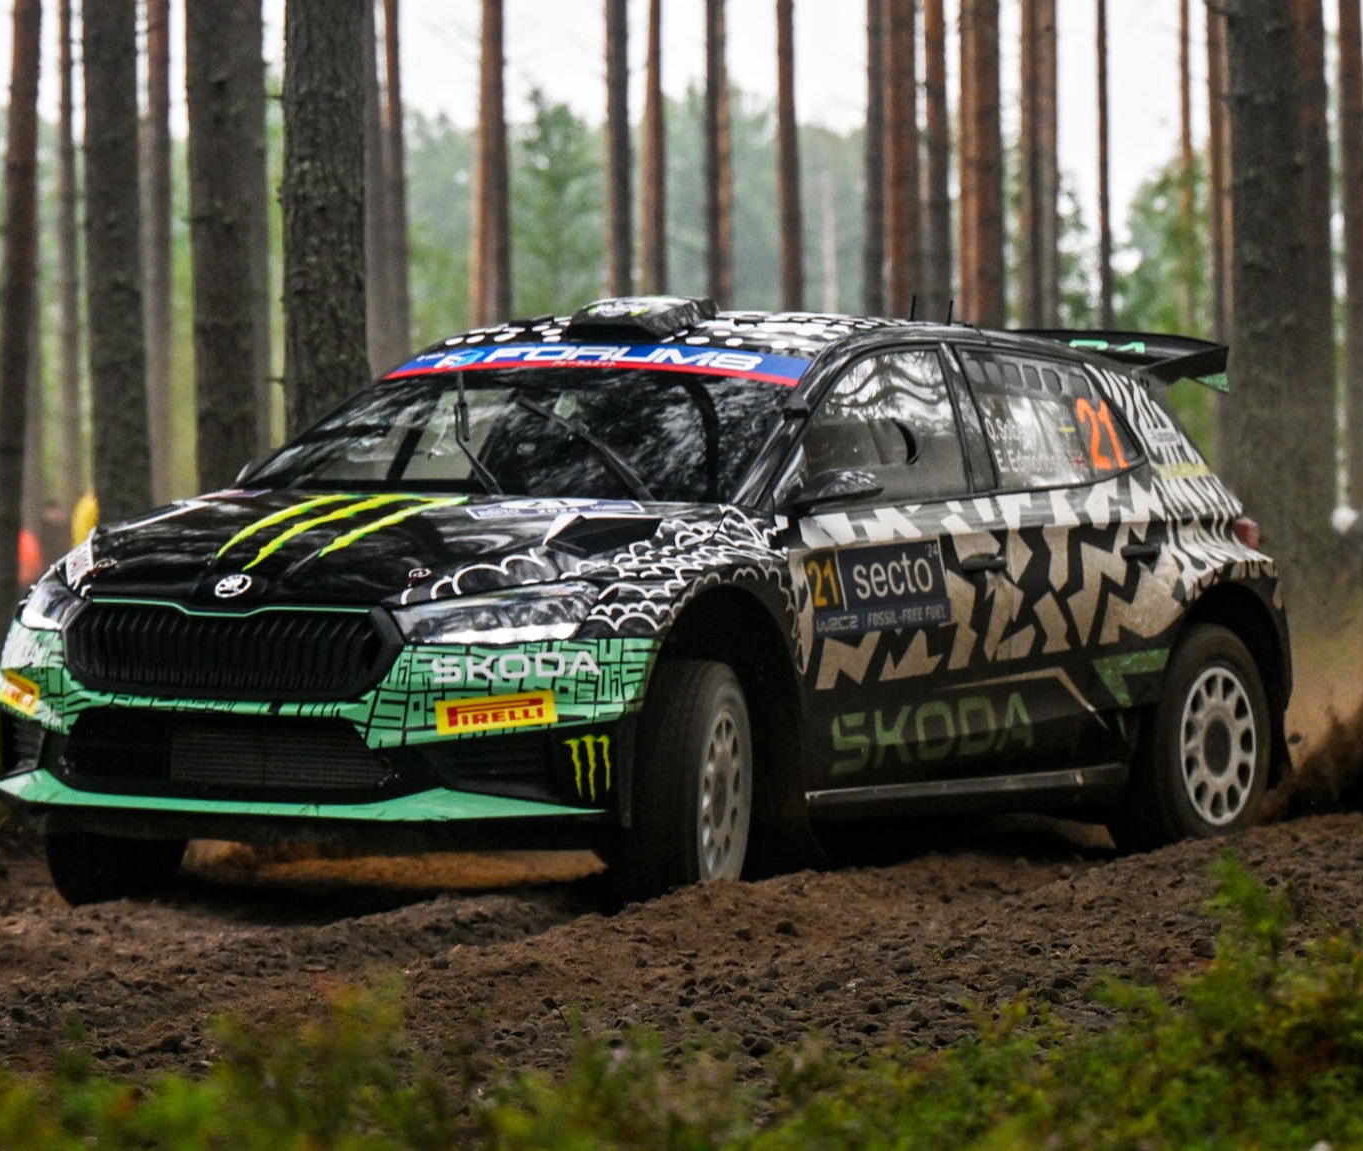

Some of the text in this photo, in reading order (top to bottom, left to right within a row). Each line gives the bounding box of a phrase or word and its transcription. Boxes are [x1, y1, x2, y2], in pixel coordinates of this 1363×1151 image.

[485, 345, 763, 371] FORUM8
[1075, 397, 1129, 470] 21
[807, 552, 933, 607] 21 secto
[867, 604, 925, 628] FOSSIL-FREE
[925, 603, 947, 621] FUEL
[447, 697, 544, 728] PIRELLI
